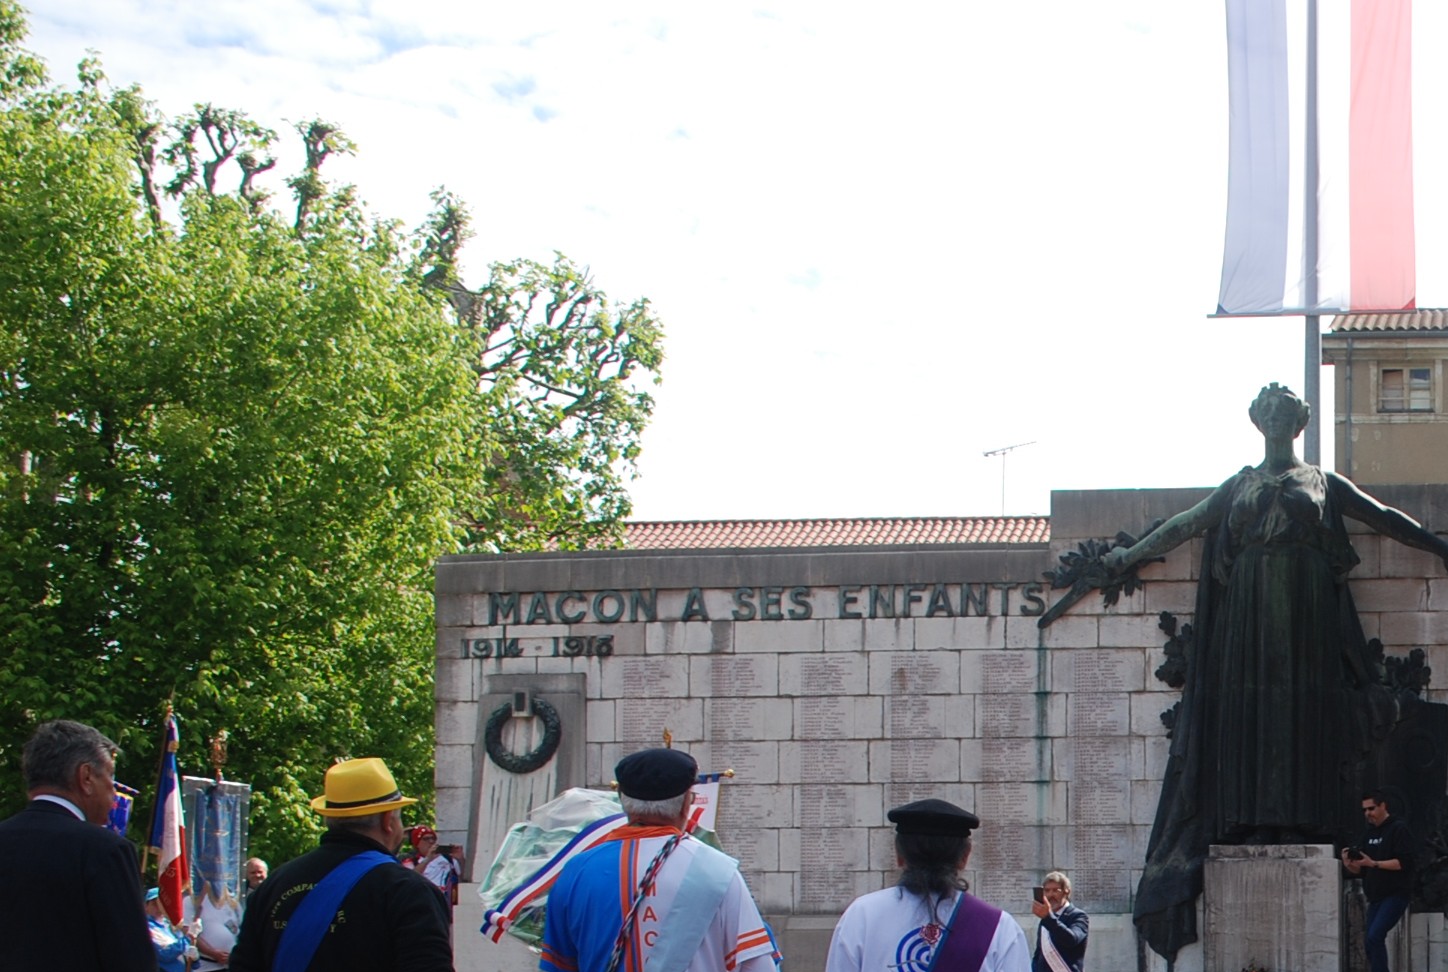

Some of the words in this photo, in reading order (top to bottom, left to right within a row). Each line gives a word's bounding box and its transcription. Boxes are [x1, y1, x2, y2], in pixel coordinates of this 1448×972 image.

[488, 587, 658, 626] MACON
[681, 586, 709, 622] A
[732, 585, 813, 621] SES
[838, 582, 1046, 619] ENFANTS
[461, 637, 524, 659] 1914
[553, 634, 615, 658] 1918
